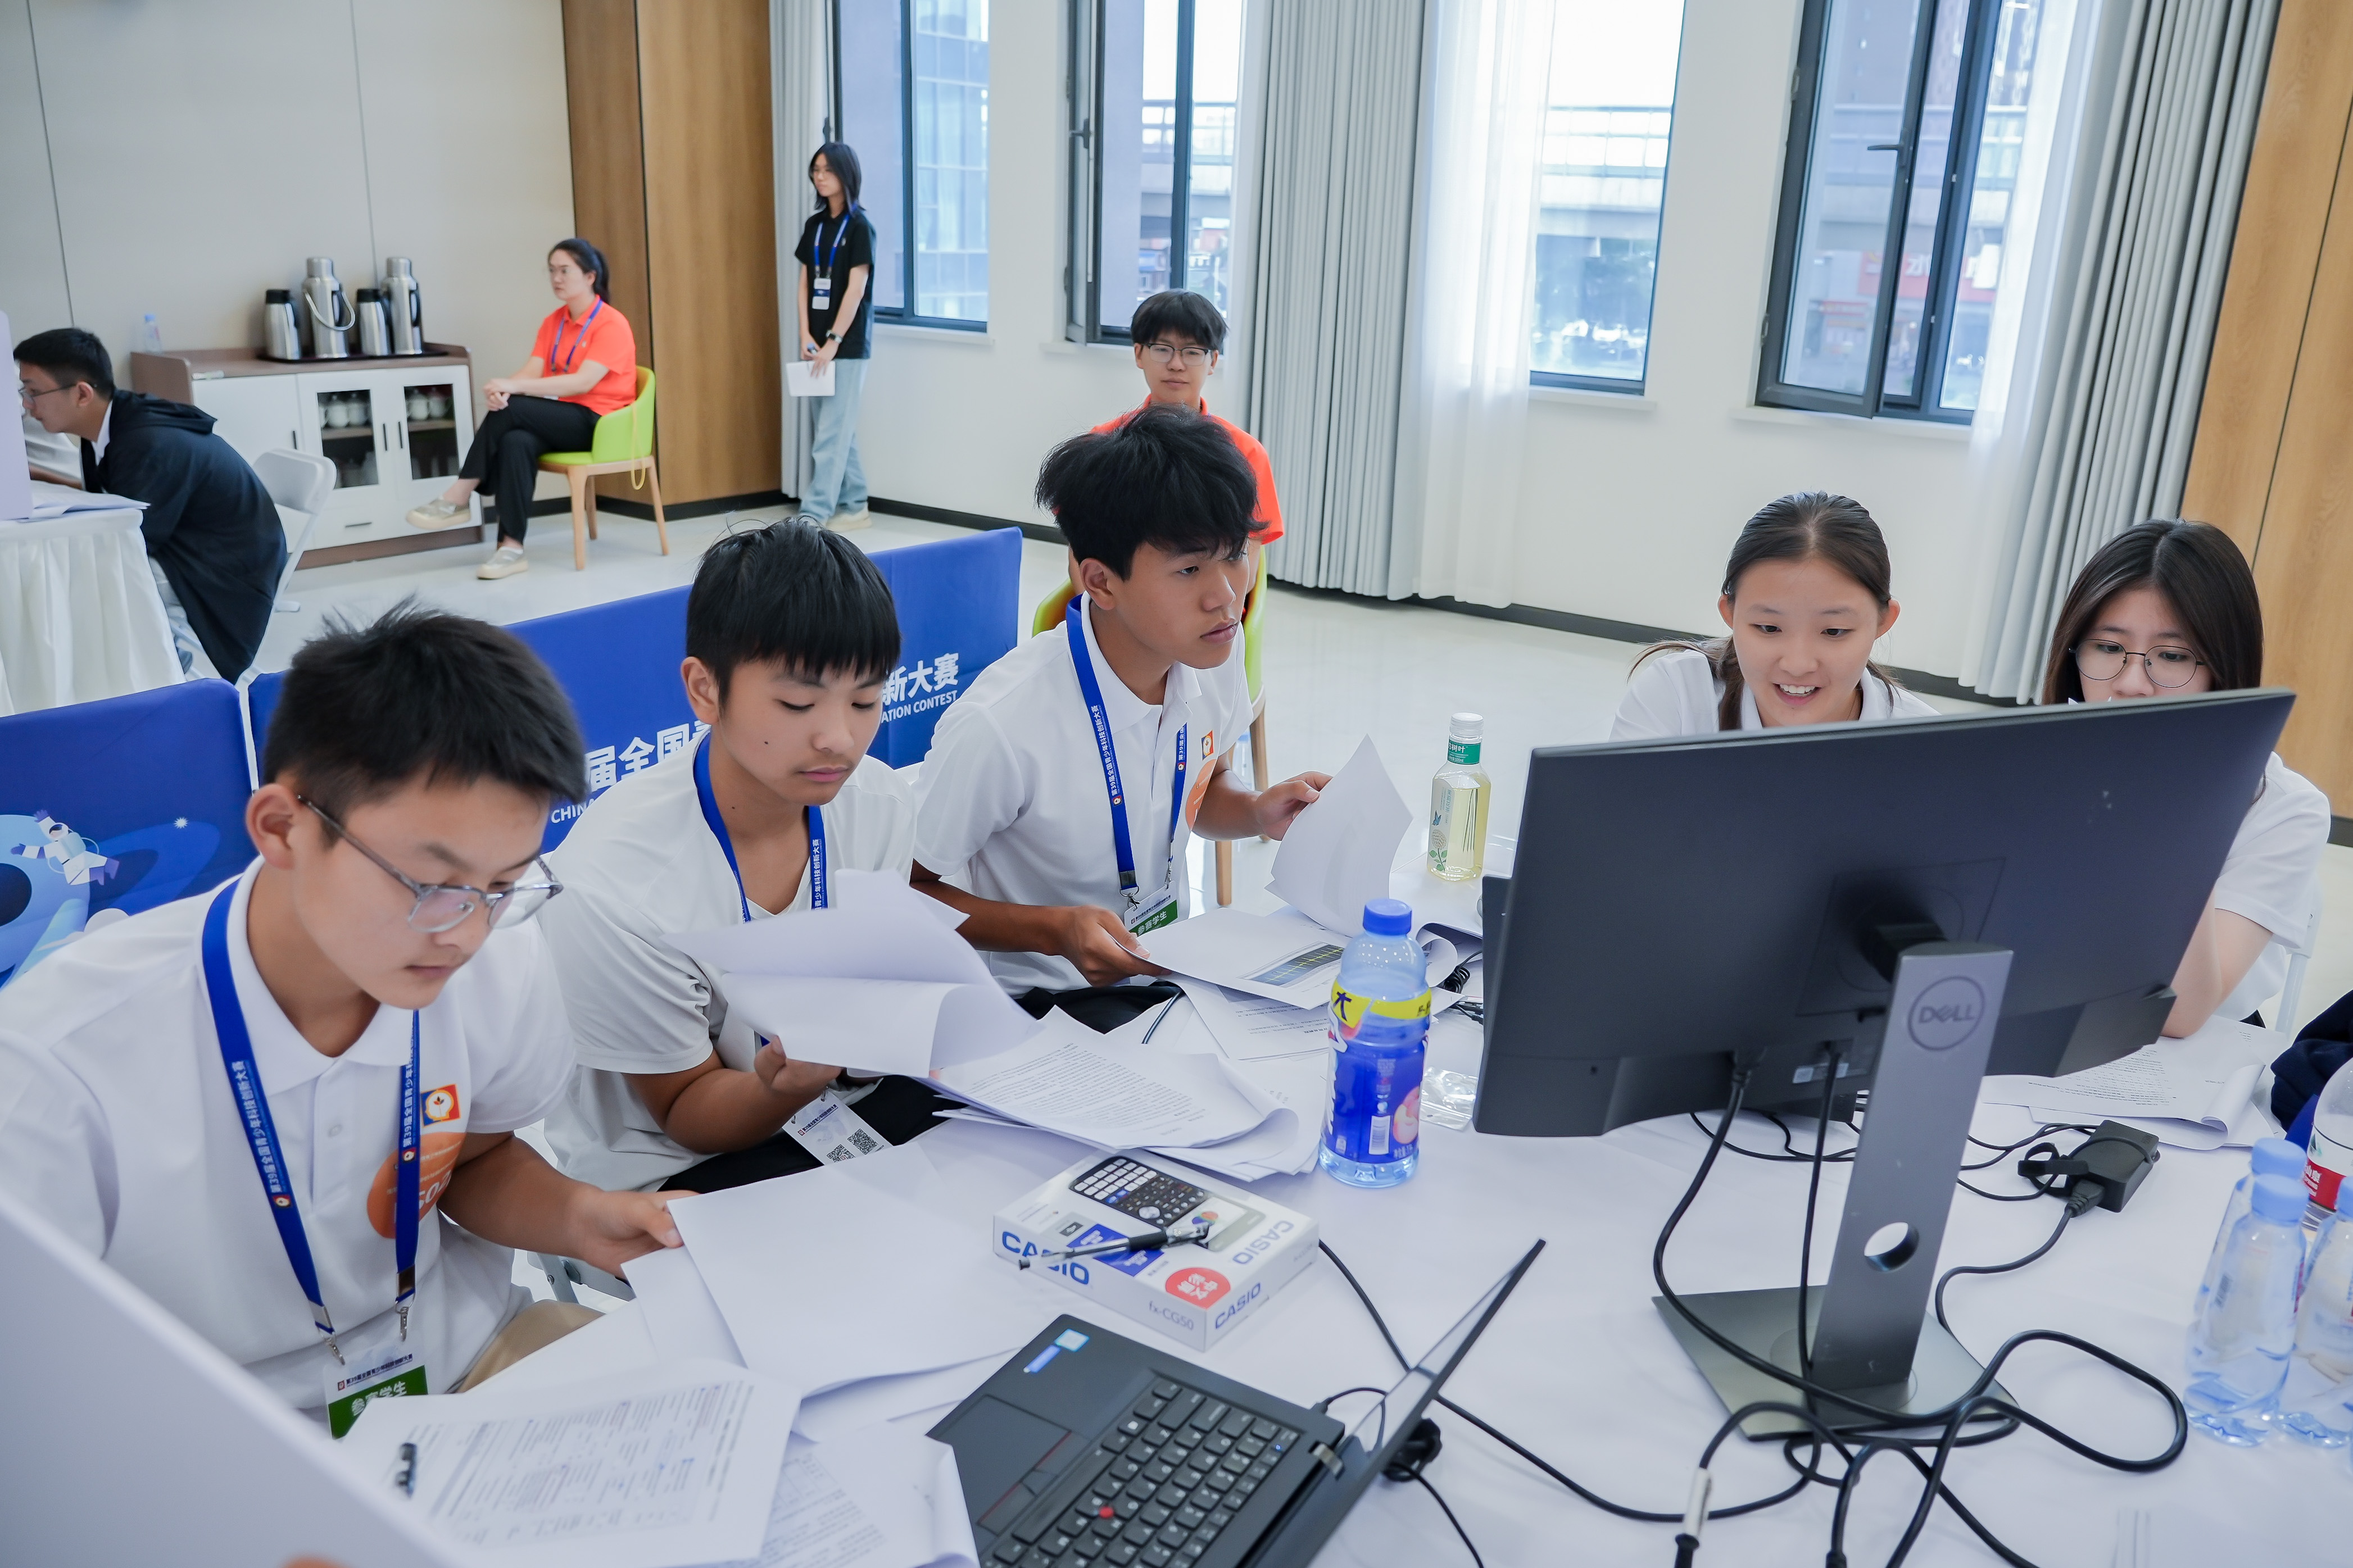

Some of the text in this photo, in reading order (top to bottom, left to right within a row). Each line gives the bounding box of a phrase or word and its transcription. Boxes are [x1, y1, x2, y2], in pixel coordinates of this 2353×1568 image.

[882, 653, 959, 706] 新大赛
[913, 690, 957, 713] CONTEST
[1091, 705, 1118, 796] 第39届全国青少年科技创新大赛
[1138, 911, 1167, 935] 参赛学生
[1918, 1004, 1977, 1022] DELL
[1232, 1220, 1294, 1264] CASIO
[1149, 1300, 1194, 1330] fx-CG50
[1216, 1282, 1261, 1329] CASIO
